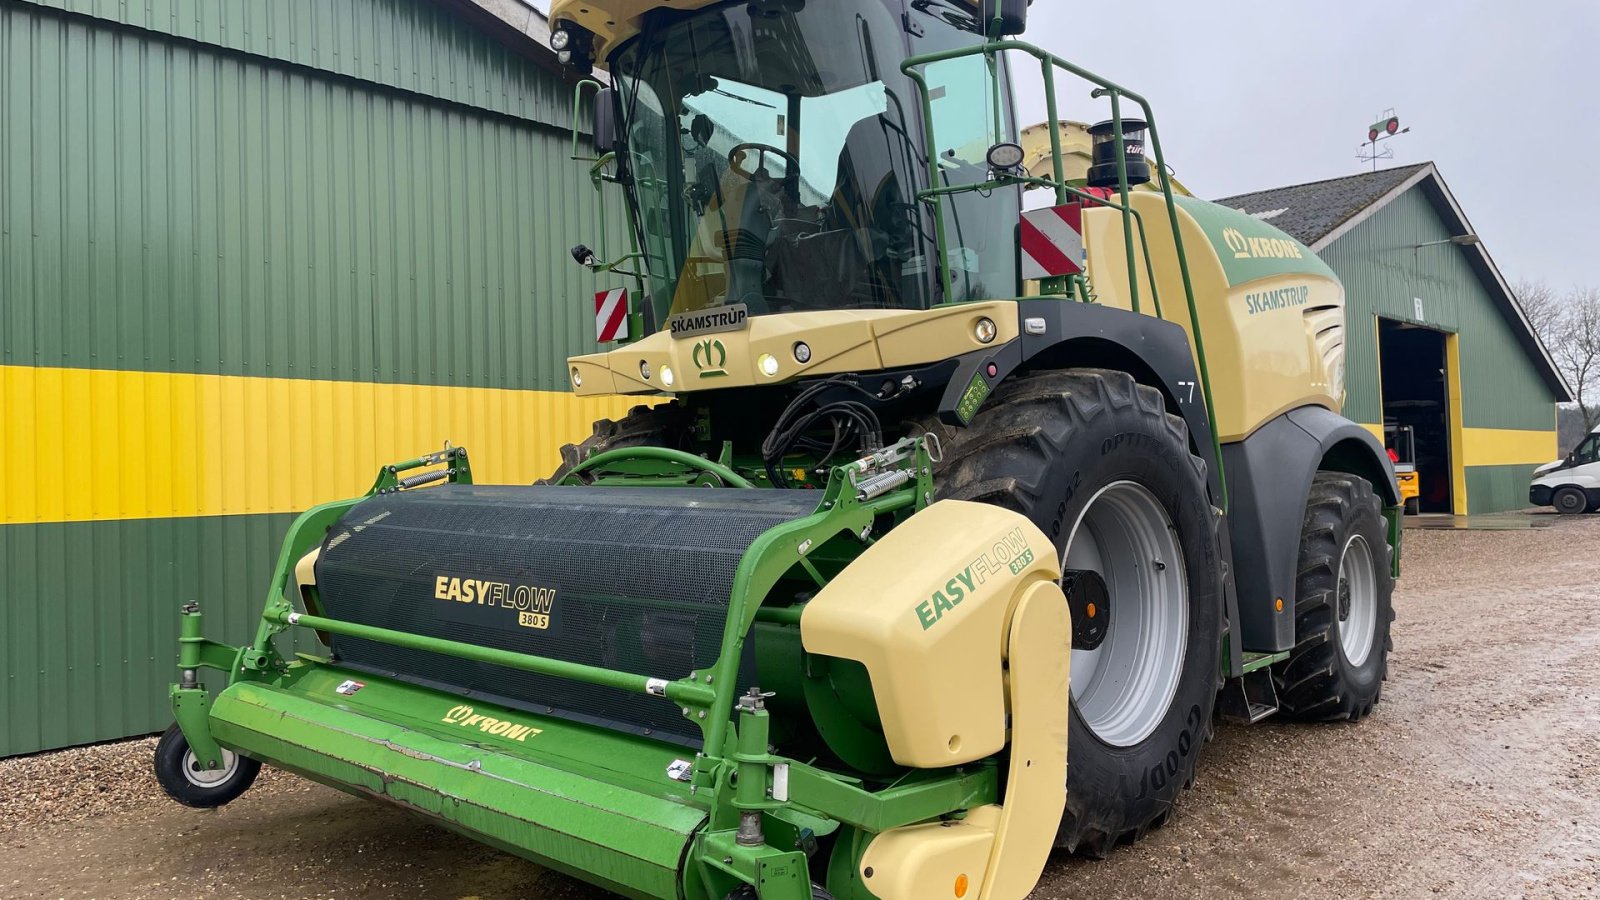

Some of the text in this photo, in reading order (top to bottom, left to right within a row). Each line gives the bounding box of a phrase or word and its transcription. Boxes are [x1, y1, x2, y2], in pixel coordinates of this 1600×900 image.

[1247, 237, 1303, 259] KRONE
[1245, 285, 1309, 315] SKAMSTRUP
[671, 309, 746, 333] SKAMSTRUP
[1012, 550, 1033, 574] 380 S
[915, 526, 1029, 631] EASYFLOW
[434, 575, 556, 614] EASYFLOW
[521, 613, 546, 627] 380 S
